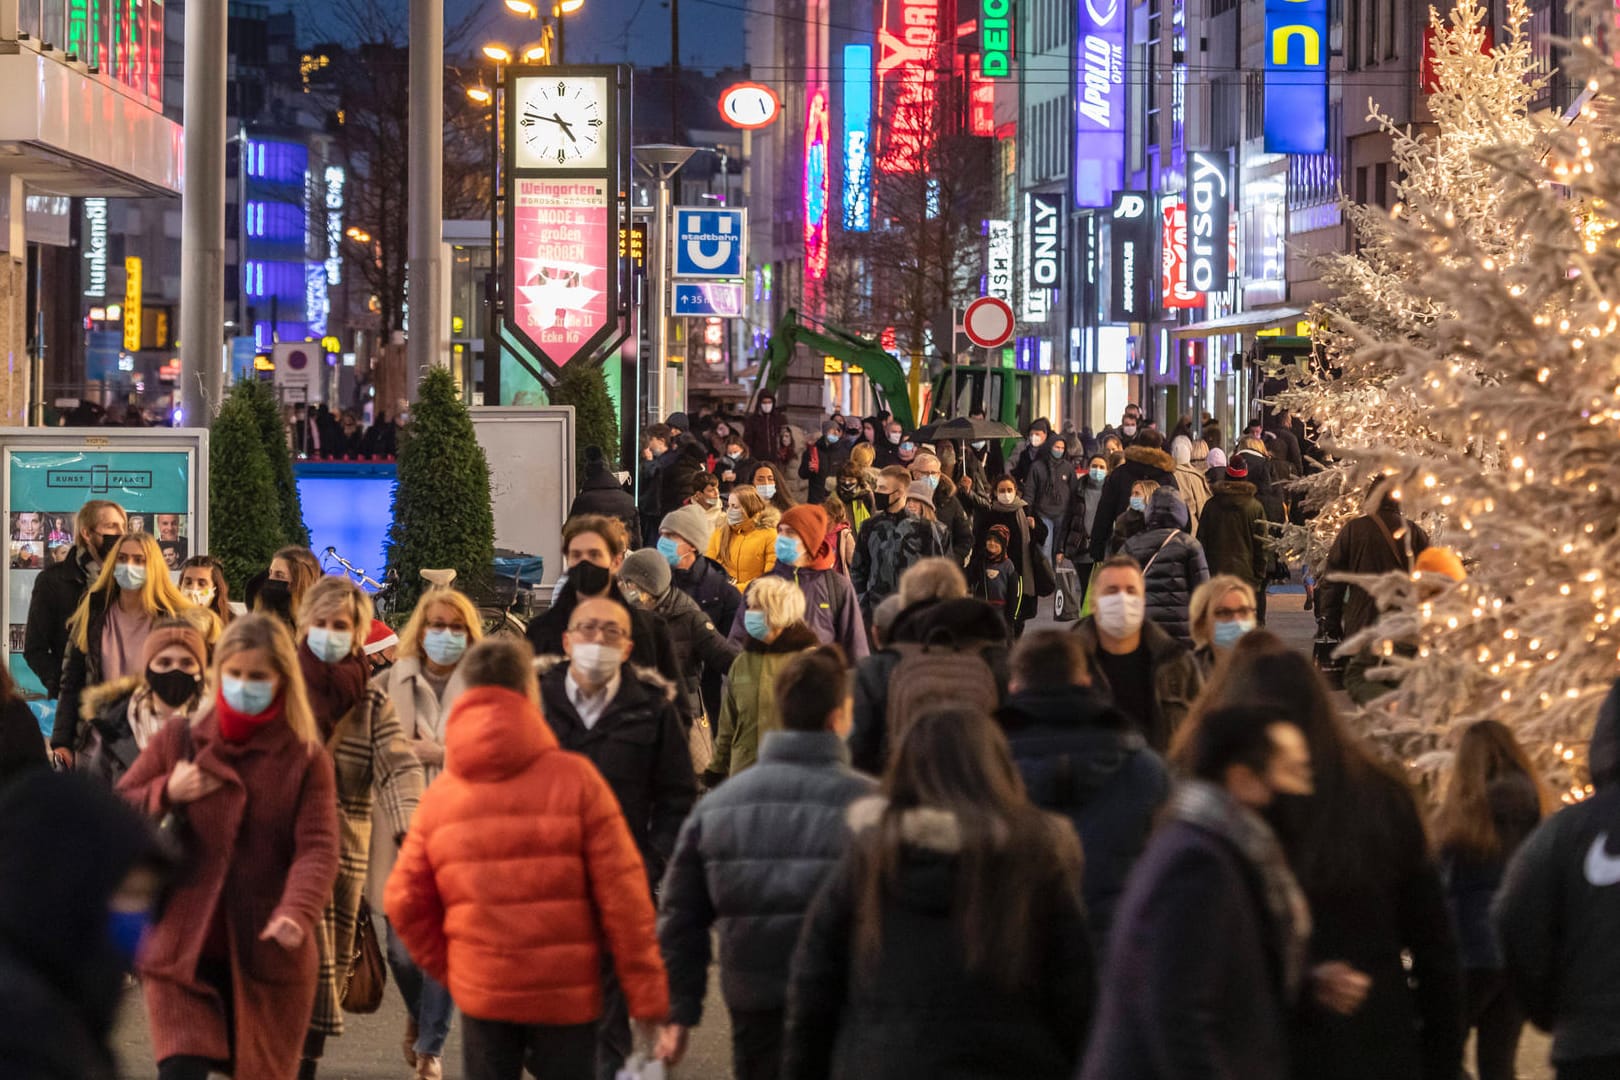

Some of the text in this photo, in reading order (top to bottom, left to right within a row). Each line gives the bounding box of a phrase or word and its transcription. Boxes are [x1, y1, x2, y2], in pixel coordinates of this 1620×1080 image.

[1079, 35, 1111, 128] APOLLO
[1109, 44, 1122, 84] OPTIK
[1034, 200, 1057, 283] ONLY
[1193, 152, 1226, 290] orsay
[541, 331, 563, 343] Ecke
